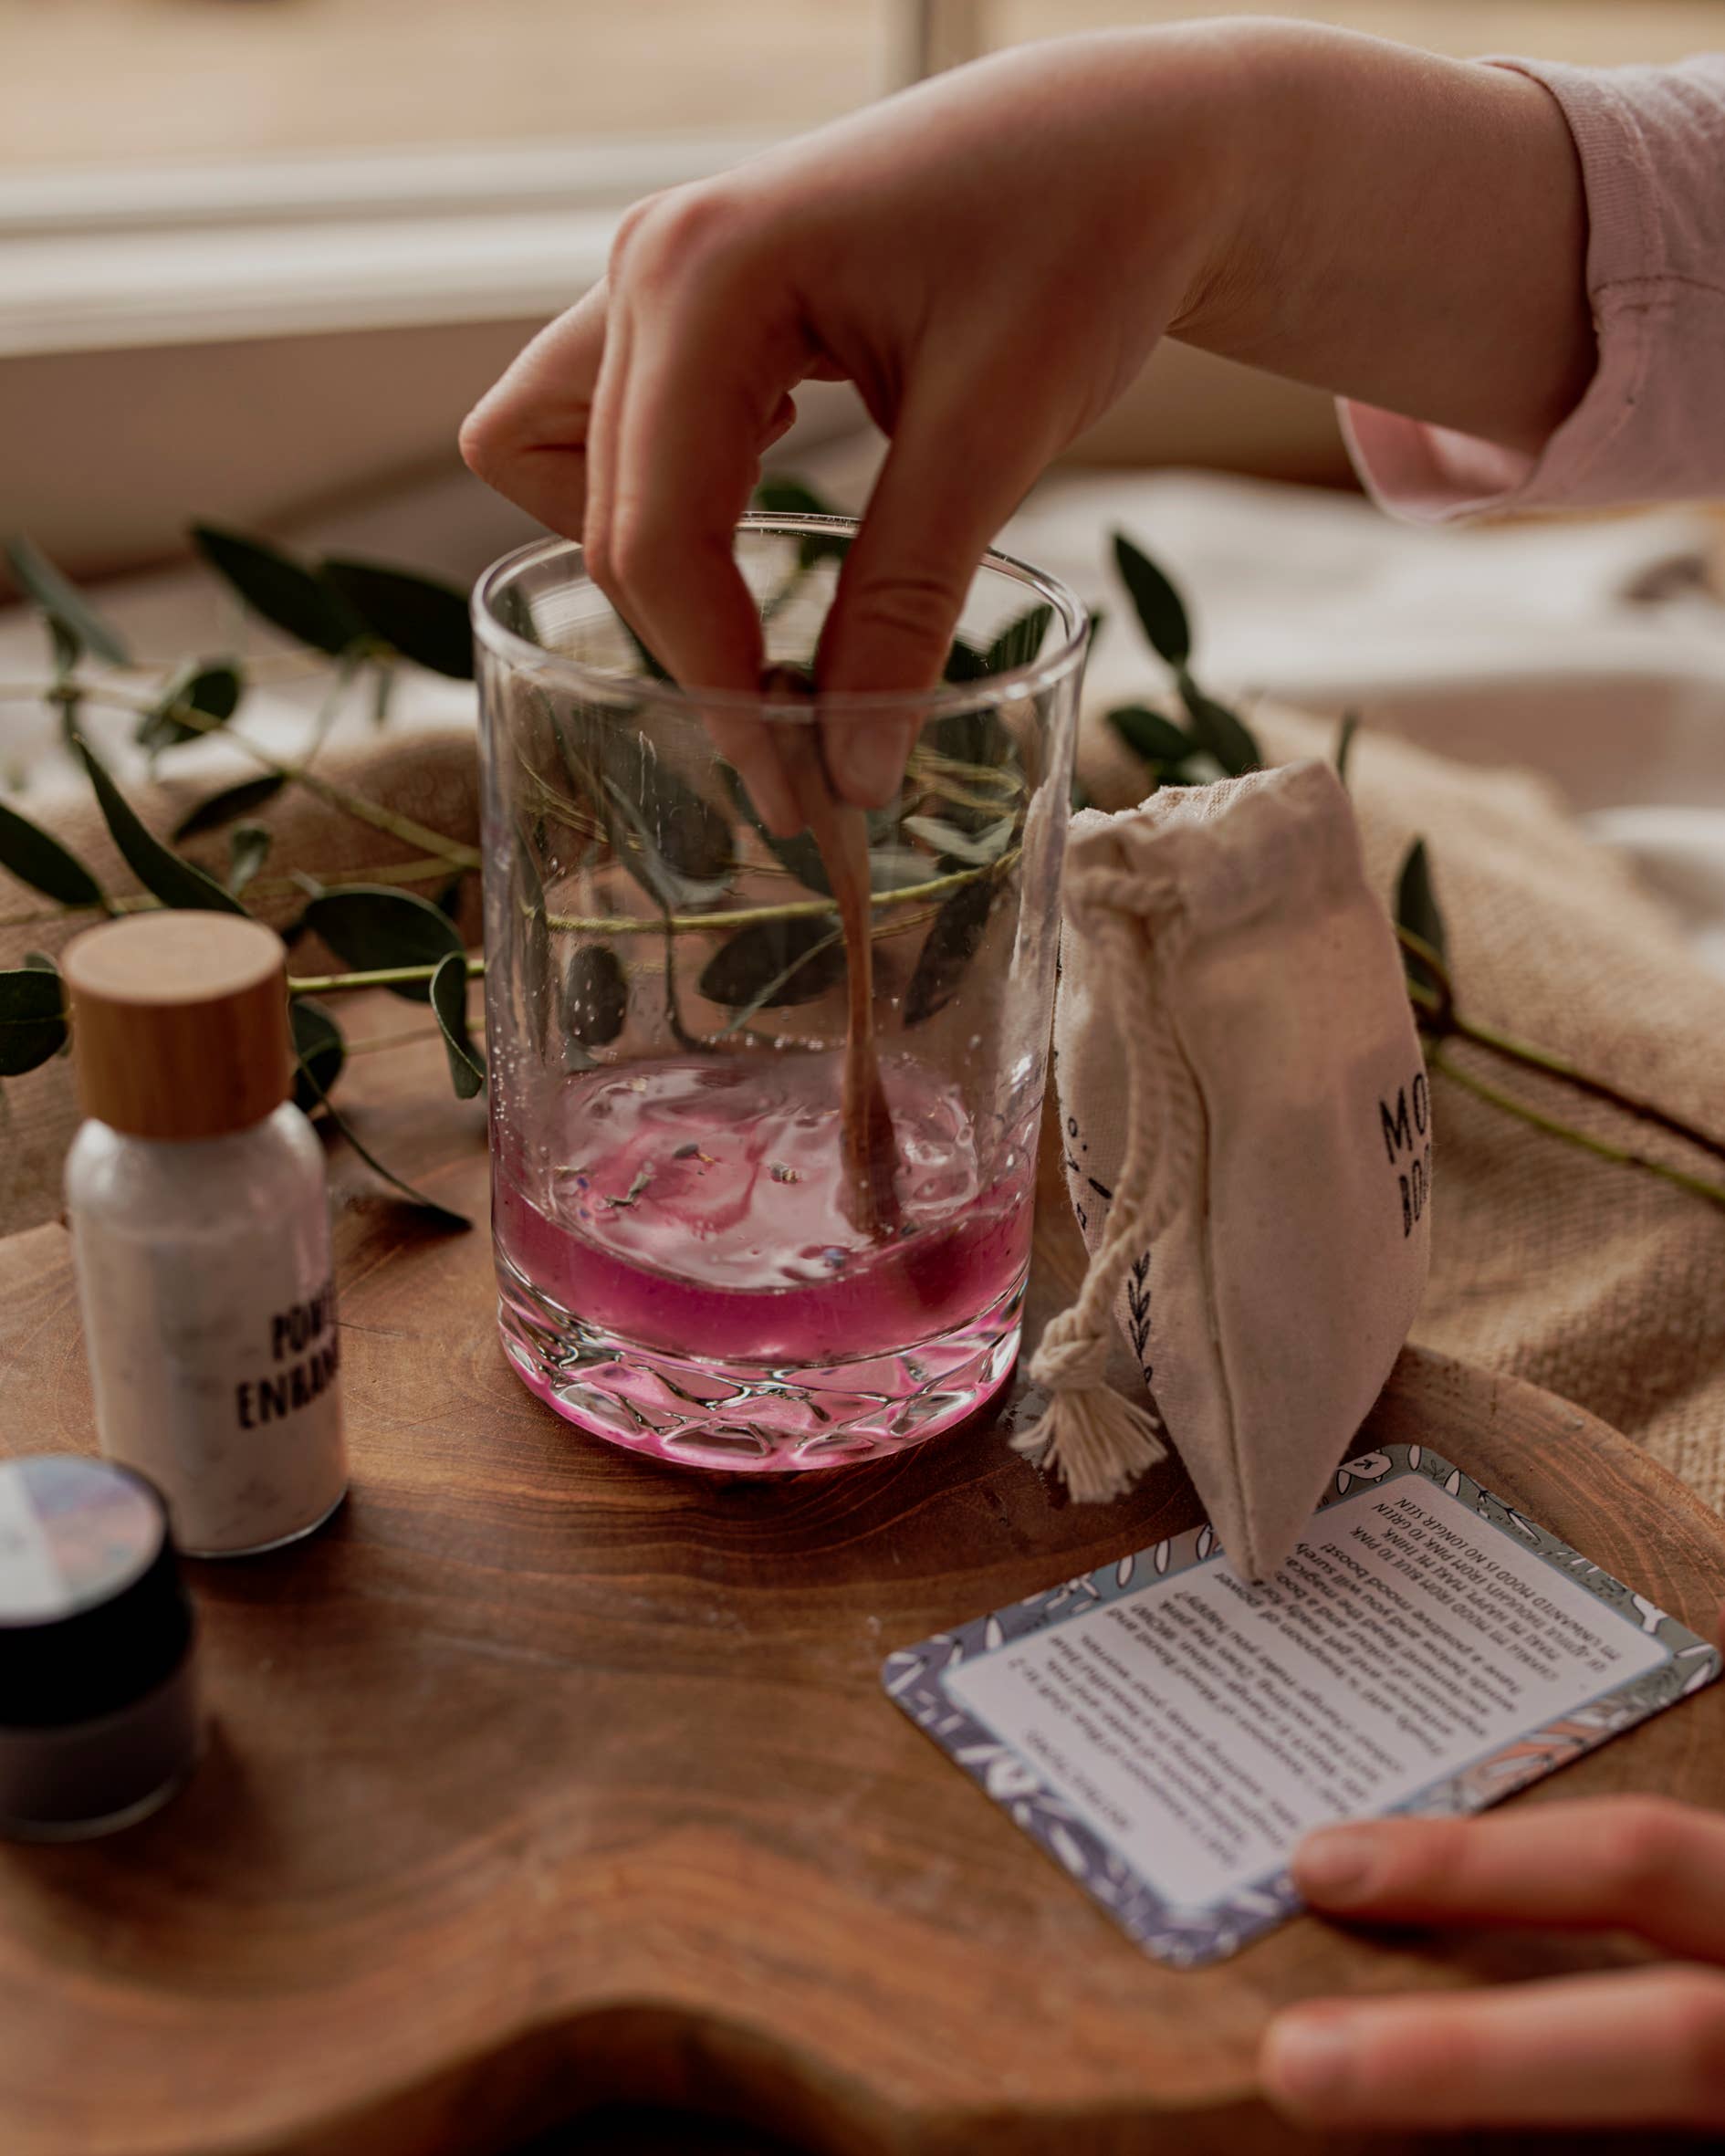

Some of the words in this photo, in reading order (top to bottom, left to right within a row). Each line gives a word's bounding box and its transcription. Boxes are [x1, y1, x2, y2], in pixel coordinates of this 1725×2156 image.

[1369, 1501, 1417, 1531] GREEN
[1389, 1495, 1428, 1520] SEEN.
[1345, 1525, 1385, 1551] PINK
[1404, 1525, 1431, 1542] TO
[1417, 1515, 1470, 1550] LONGER
[1288, 1541, 1341, 1576] surely
[1318, 1542, 1372, 1578] boost!
[1374, 1546, 1399, 1561] TO
[1410, 1553, 1438, 1569] ME
[1418, 1536, 1458, 1562] PINK
[1459, 1546, 1490, 1565] NO
[1387, 1556, 1427, 1582] BLUE
[1427, 1565, 1470, 1593] MAKE
[1448, 1557, 1490, 1586] FROM
[1479, 1561, 1501, 1573] IS
[1209, 1569, 1266, 1610] power
[1257, 1585, 1291, 1606] for
[1329, 1572, 1367, 1596] will
[1363, 1575, 1417, 1612] mood
[1415, 1577, 1459, 1607] FROM
[1490, 1569, 1537, 1599] MOOD
[1154, 1596, 1198, 1628] pink
[1170, 1586, 1236, 1634] happy?
[1301, 1595, 1323, 1608] a
[1331, 1596, 1368, 1621] the
[1354, 1592, 1395, 1618] you
[1479, 1580, 1551, 1629] THOUGHTS
[1257, 1607, 1285, 1626] of
[1280, 1602, 1331, 1638] ready
[1312, 1605, 1351, 1630] and
[1385, 1614, 1425, 1641] and
[1446, 1600, 1495, 1633] MOOD
[1527, 1596, 1604, 1648] UNWANTED
[1187, 1625, 1222, 1648] the
[1221, 1628, 1263, 1657] you
[1320, 1634, 1355, 1658] get
[1356, 1617, 1405, 1649] Read
[1406, 1608, 1474, 1657] positive
[1340, 1627, 1397, 1668] colour
[1416, 1638, 1472, 1679] below
[1466, 1652, 1484, 1663] a
[1345, 1655, 1385, 1681] and
